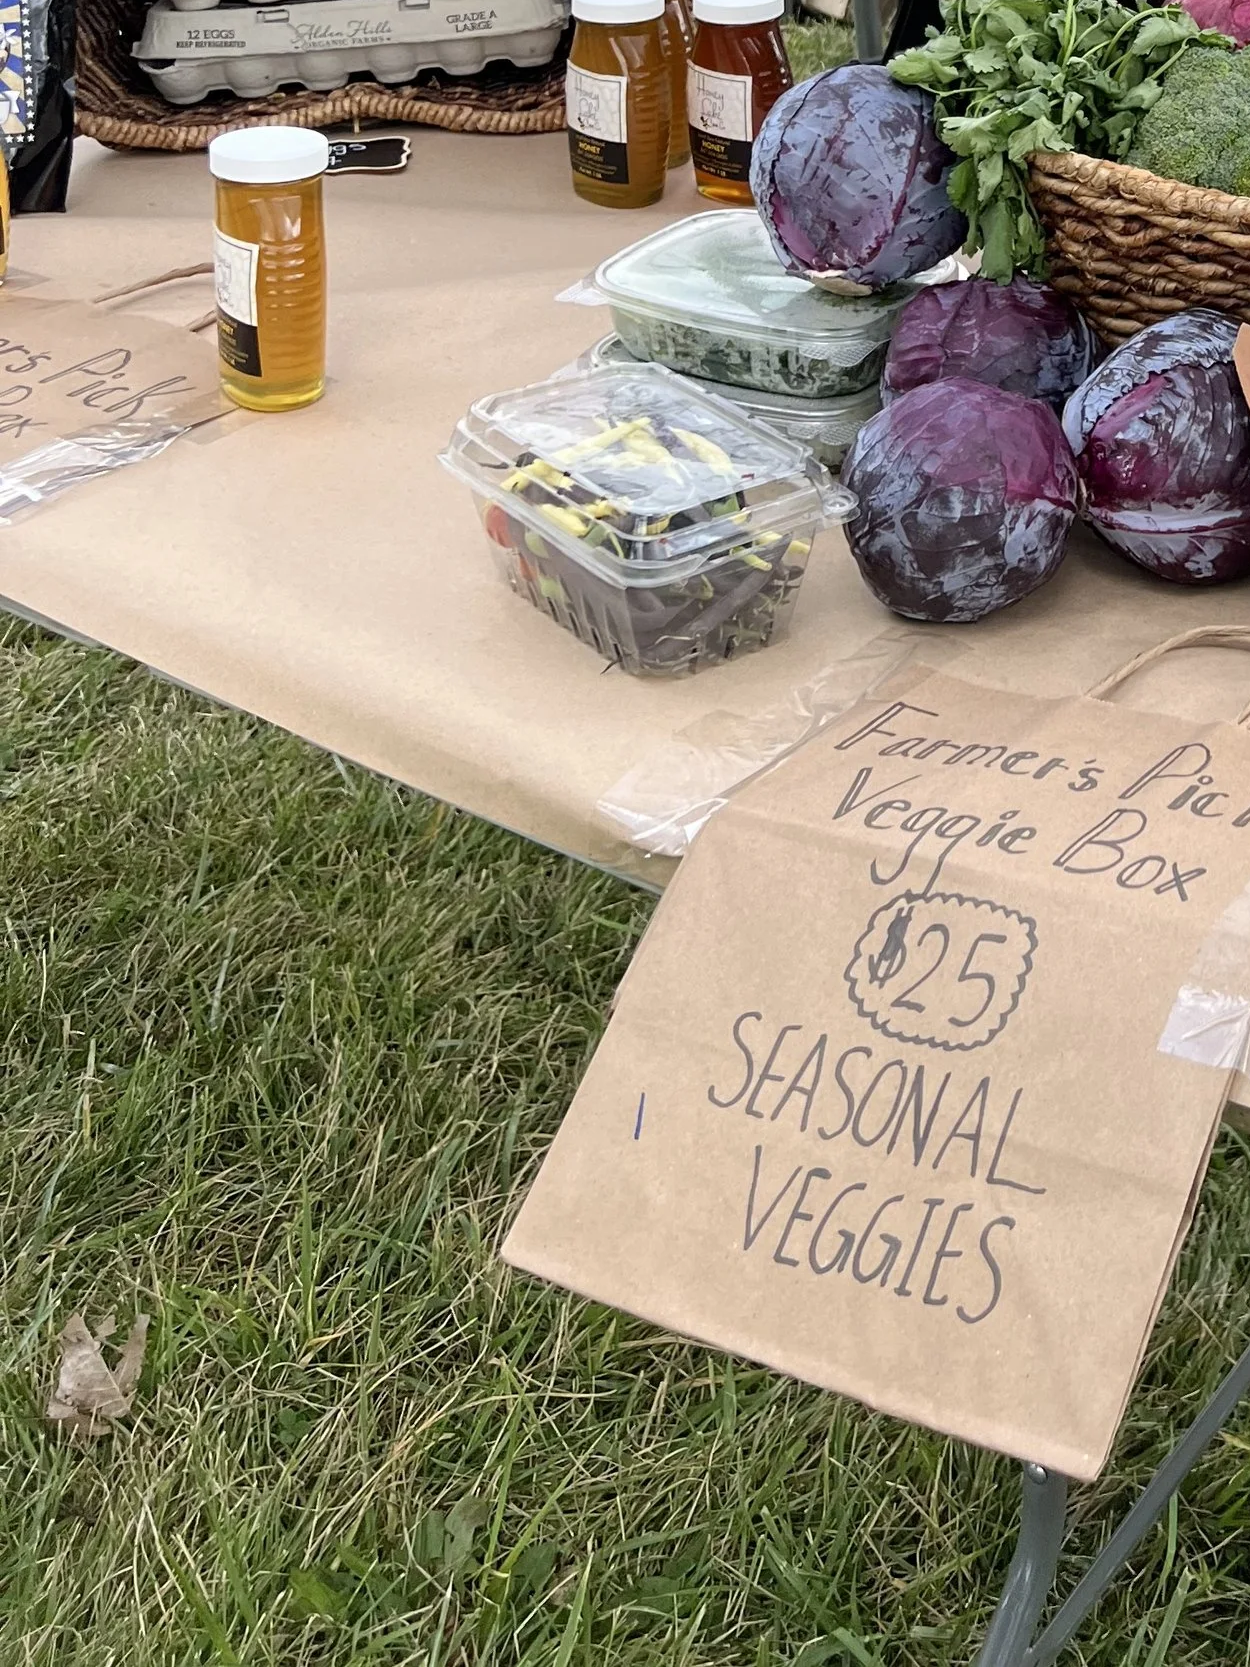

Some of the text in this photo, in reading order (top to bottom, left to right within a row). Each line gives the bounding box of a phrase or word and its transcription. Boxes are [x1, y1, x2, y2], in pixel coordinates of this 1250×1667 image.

[187, 29, 235, 40] 12 EGGS
[445, 10, 498, 24] GRADE A
[455, 21, 493, 33] LARGE
[833, 701, 1105, 792] Farmer's
[832, 766, 1037, 898] Veggie
[868, 905, 1008, 1027] $25
[707, 1011, 1048, 1195] SEASONAL
[743, 1145, 1018, 1325] VEGGIES
